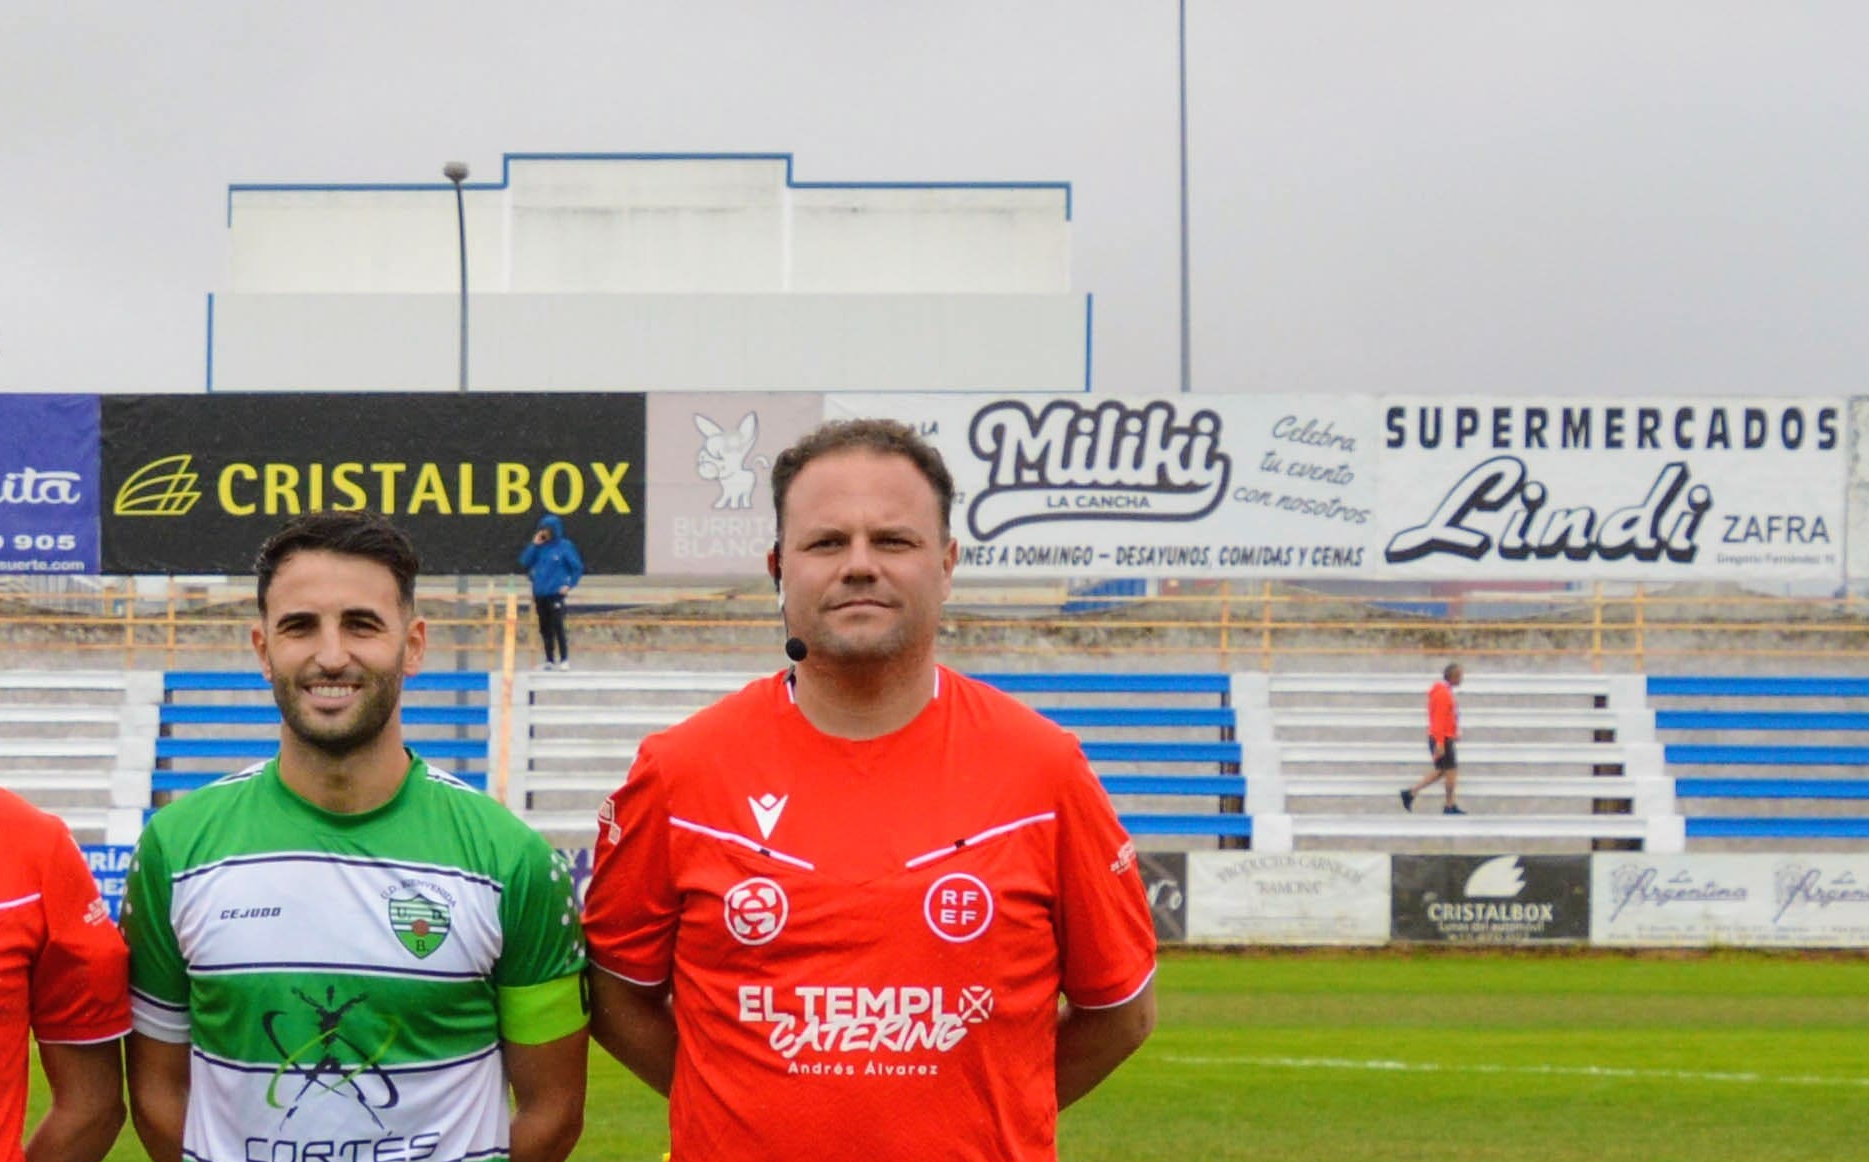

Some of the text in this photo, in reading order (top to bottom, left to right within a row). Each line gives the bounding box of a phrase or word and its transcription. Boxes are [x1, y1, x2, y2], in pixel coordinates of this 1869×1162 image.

[1385, 406, 1840, 450] SUPERMERCADOS
[970, 400, 1223, 490] Miliki
[217, 461, 631, 515] CRISTALBOX
[1046, 495, 1151, 510] LA CANCHA
[1384, 455, 1830, 565] Lindi ZAFRA
[673, 516, 775, 538] BURRIT
[12, 533, 77, 551] 905
[673, 538, 768, 559] BLANC
[1014, 545, 1094, 567] DOMINGO
[1219, 545, 1293, 567] COMIDAS
[1297, 545, 1308, 566] Y
[1310, 545, 1364, 567] CENAS
[220, 906, 282, 921] CEJUDO
[1427, 902, 1554, 922] CRISTALBOX
[738, 985, 785, 1023] EL
[768, 1015, 969, 1059] CATERING
[787, 1059, 939, 1076] Andrés Álvarez
